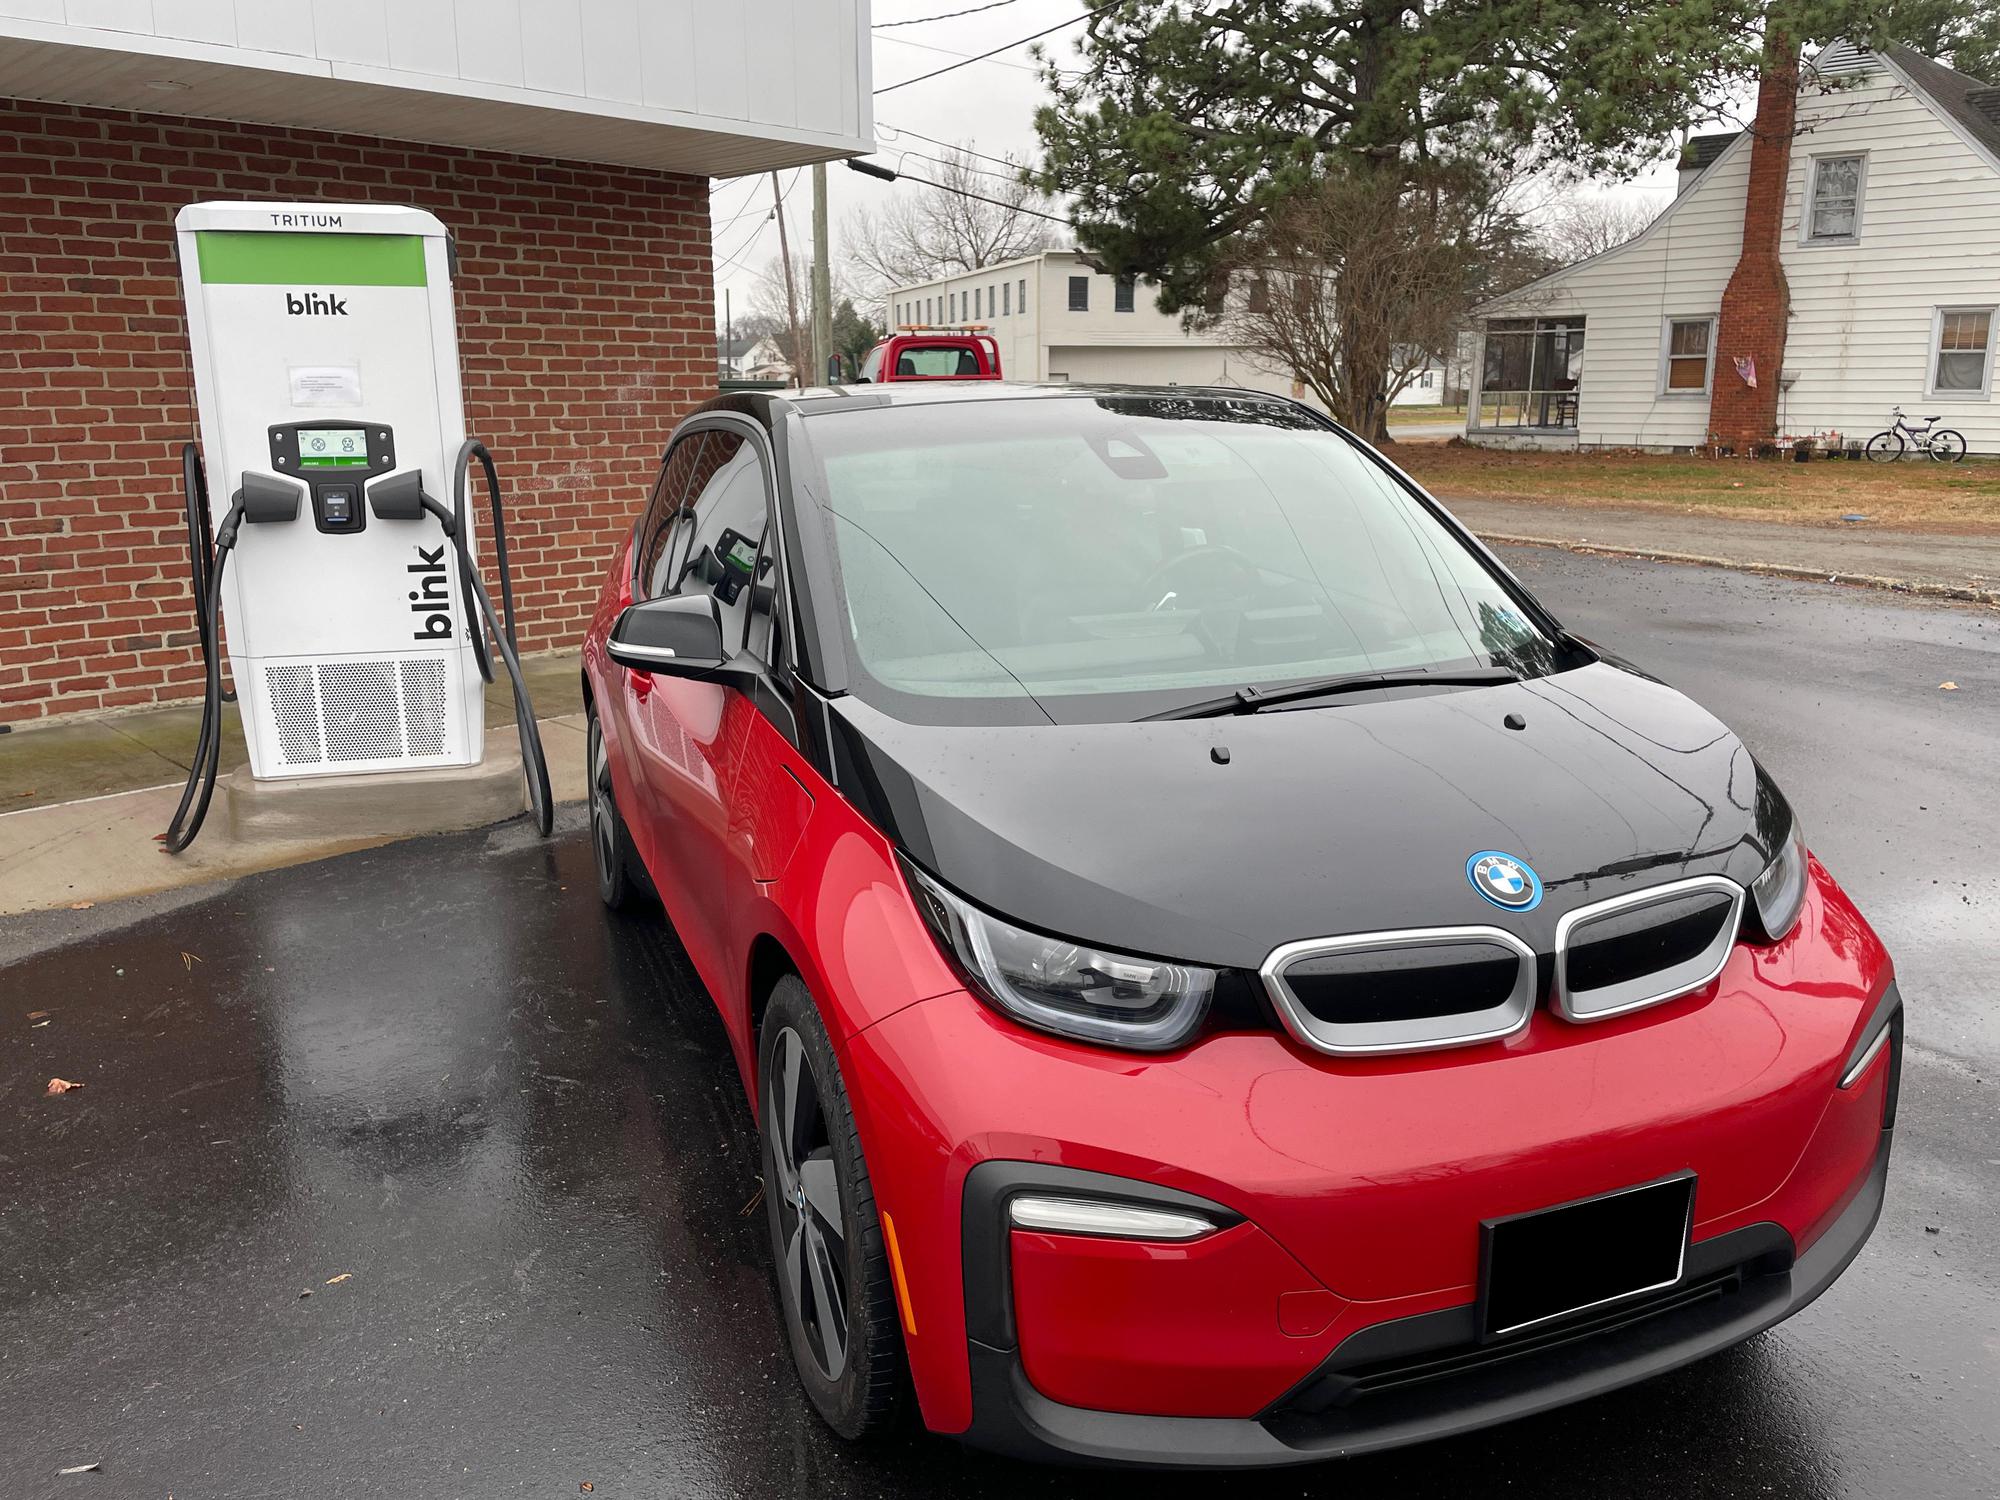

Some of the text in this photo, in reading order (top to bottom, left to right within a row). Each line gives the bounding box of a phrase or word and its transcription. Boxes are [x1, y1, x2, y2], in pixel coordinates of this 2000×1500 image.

[270, 214, 342, 228] TRITIUM
[286, 292, 349, 315] blink
[407, 544, 452, 640] blink
[1477, 856, 1519, 875] BMW
